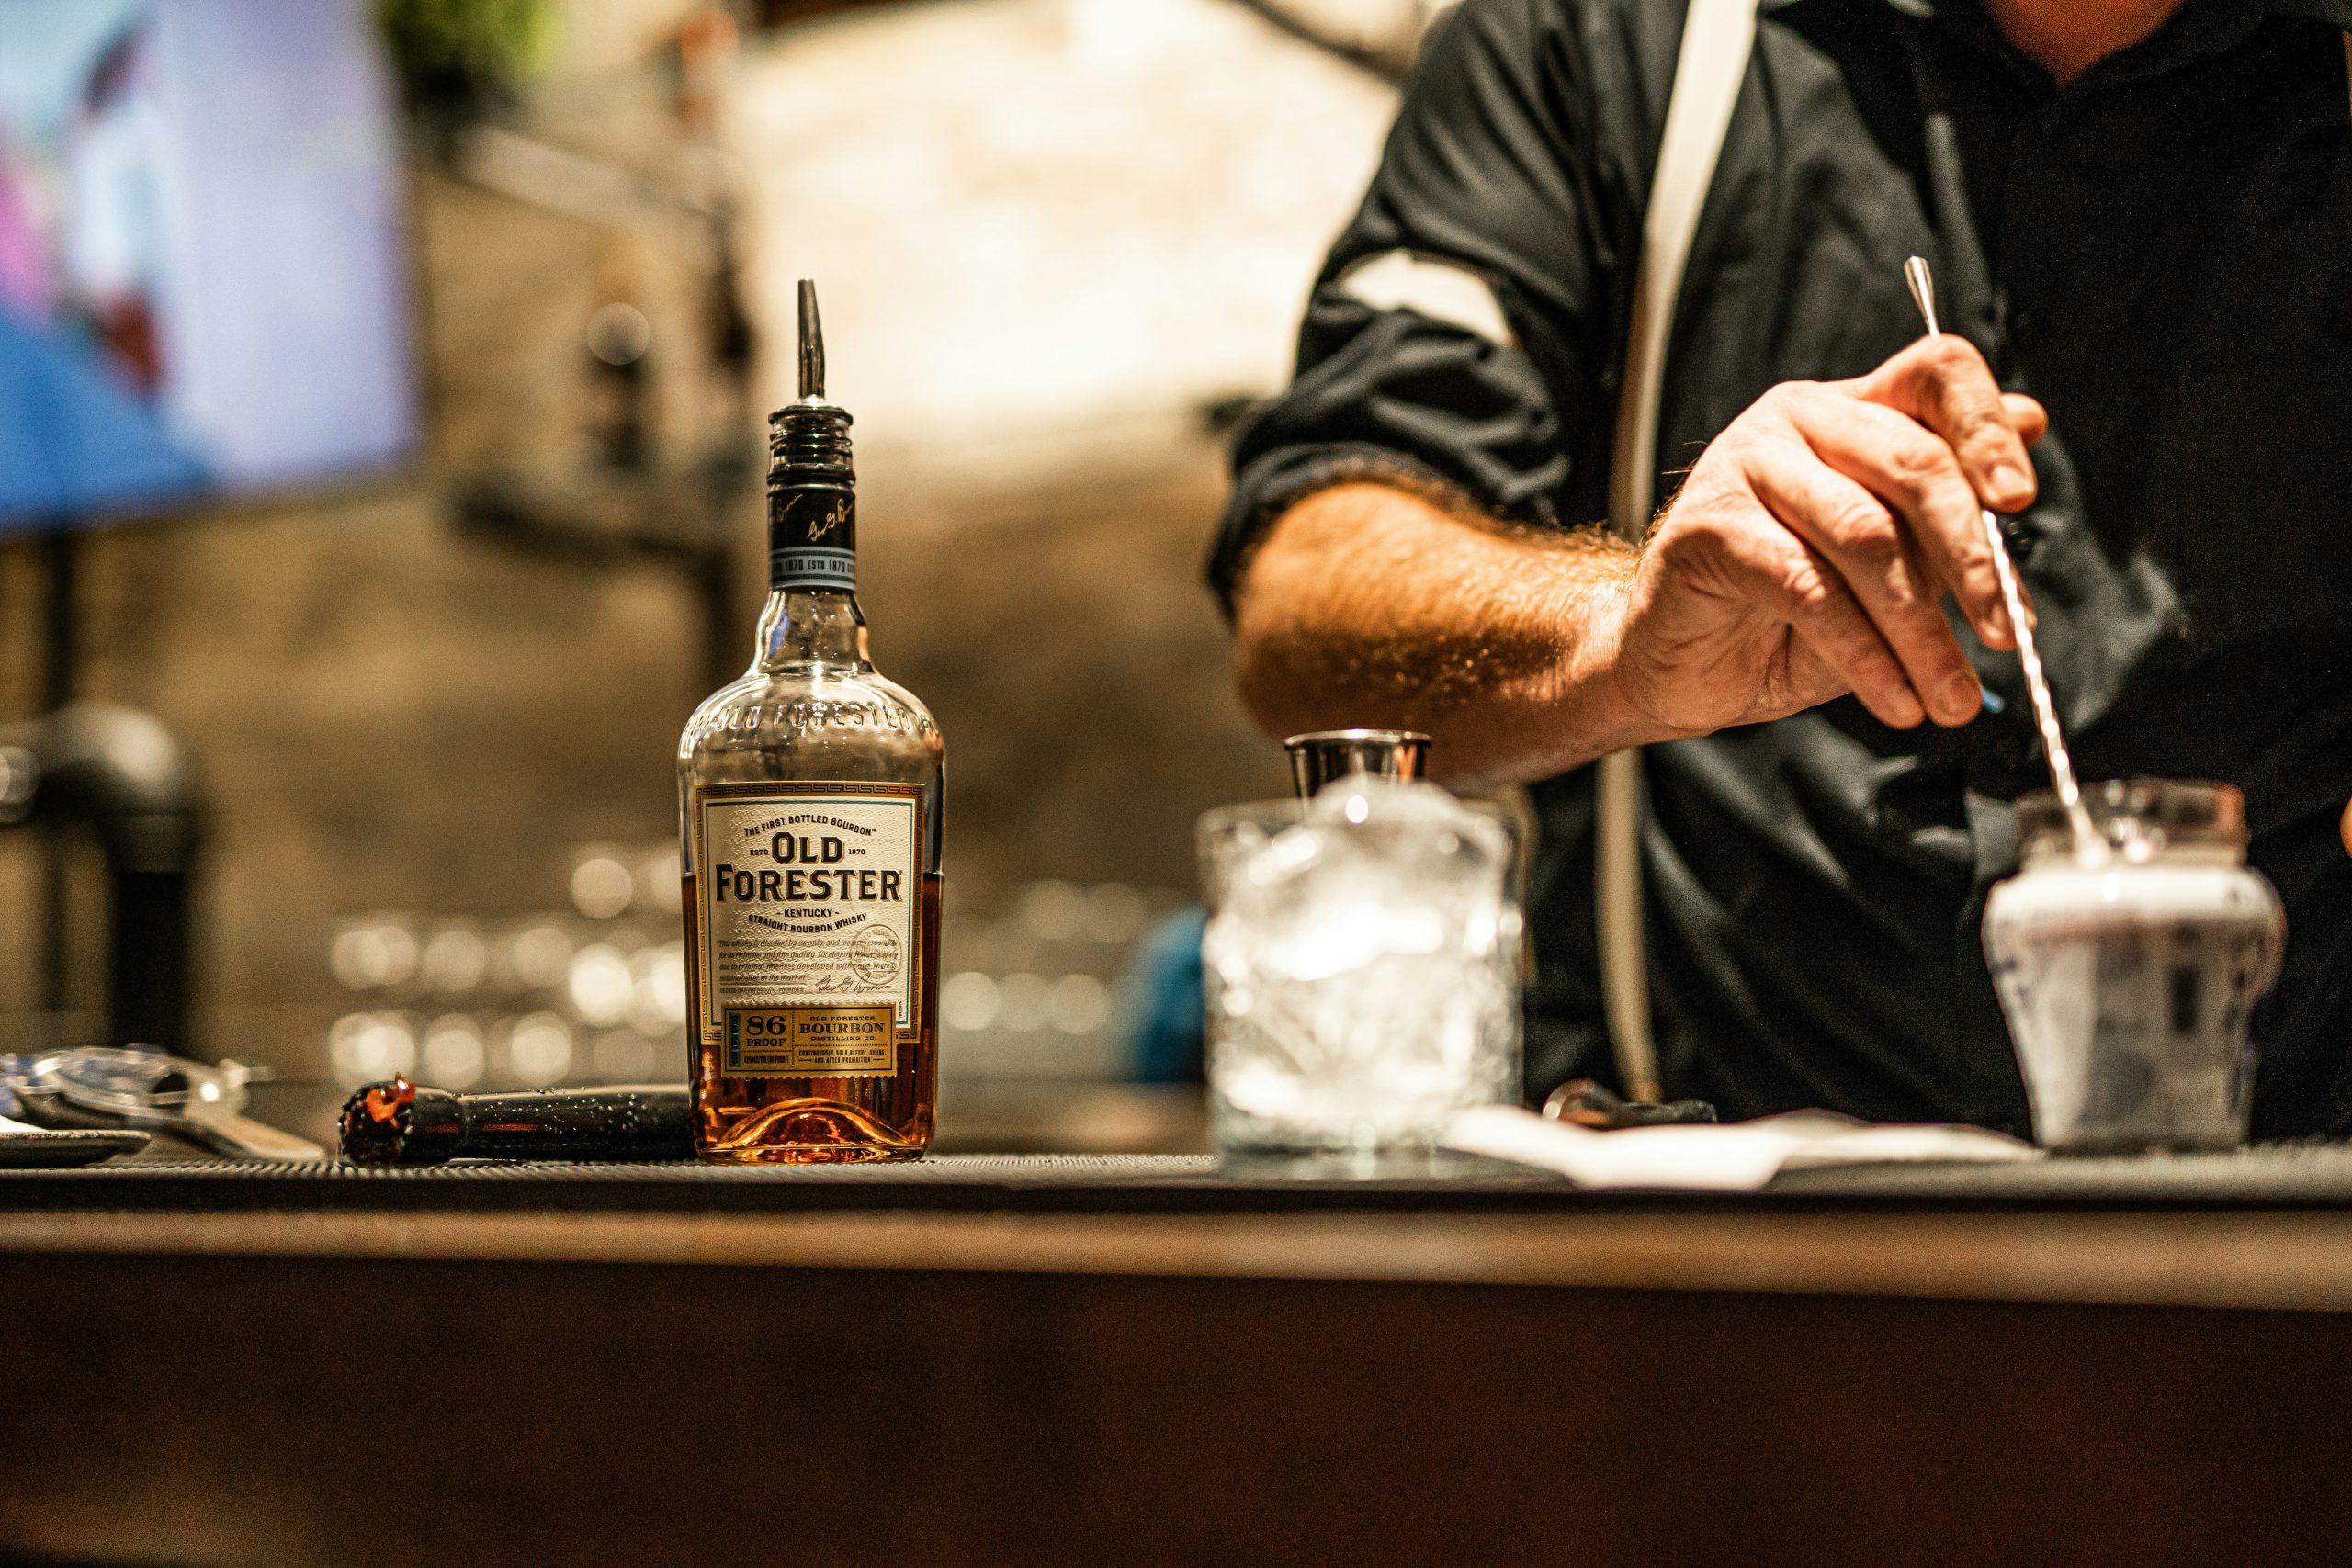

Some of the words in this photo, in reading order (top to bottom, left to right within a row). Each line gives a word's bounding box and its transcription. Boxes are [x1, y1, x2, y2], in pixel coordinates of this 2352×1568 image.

[785, 559, 803, 571] 1870
[808, 560, 825, 570] ESTD
[829, 559, 845, 572] 1870
[743, 827, 761, 837] THE
[762, 817, 786, 832] FIRST
[788, 815, 828, 824] BOTTLED
[771, 831, 845, 864] OLD
[715, 863, 903, 902] FORESTER
[748, 913, 788, 931] STRAIGHT
[790, 923, 833, 933] BOURBON
[834, 913, 867, 930] WHISKY
[784, 908, 832, 918] KENTUCKY
[746, 1015, 786, 1036] 86
[798, 1022, 885, 1034] BOURBON
[746, 1038, 786, 1047] PROOF
